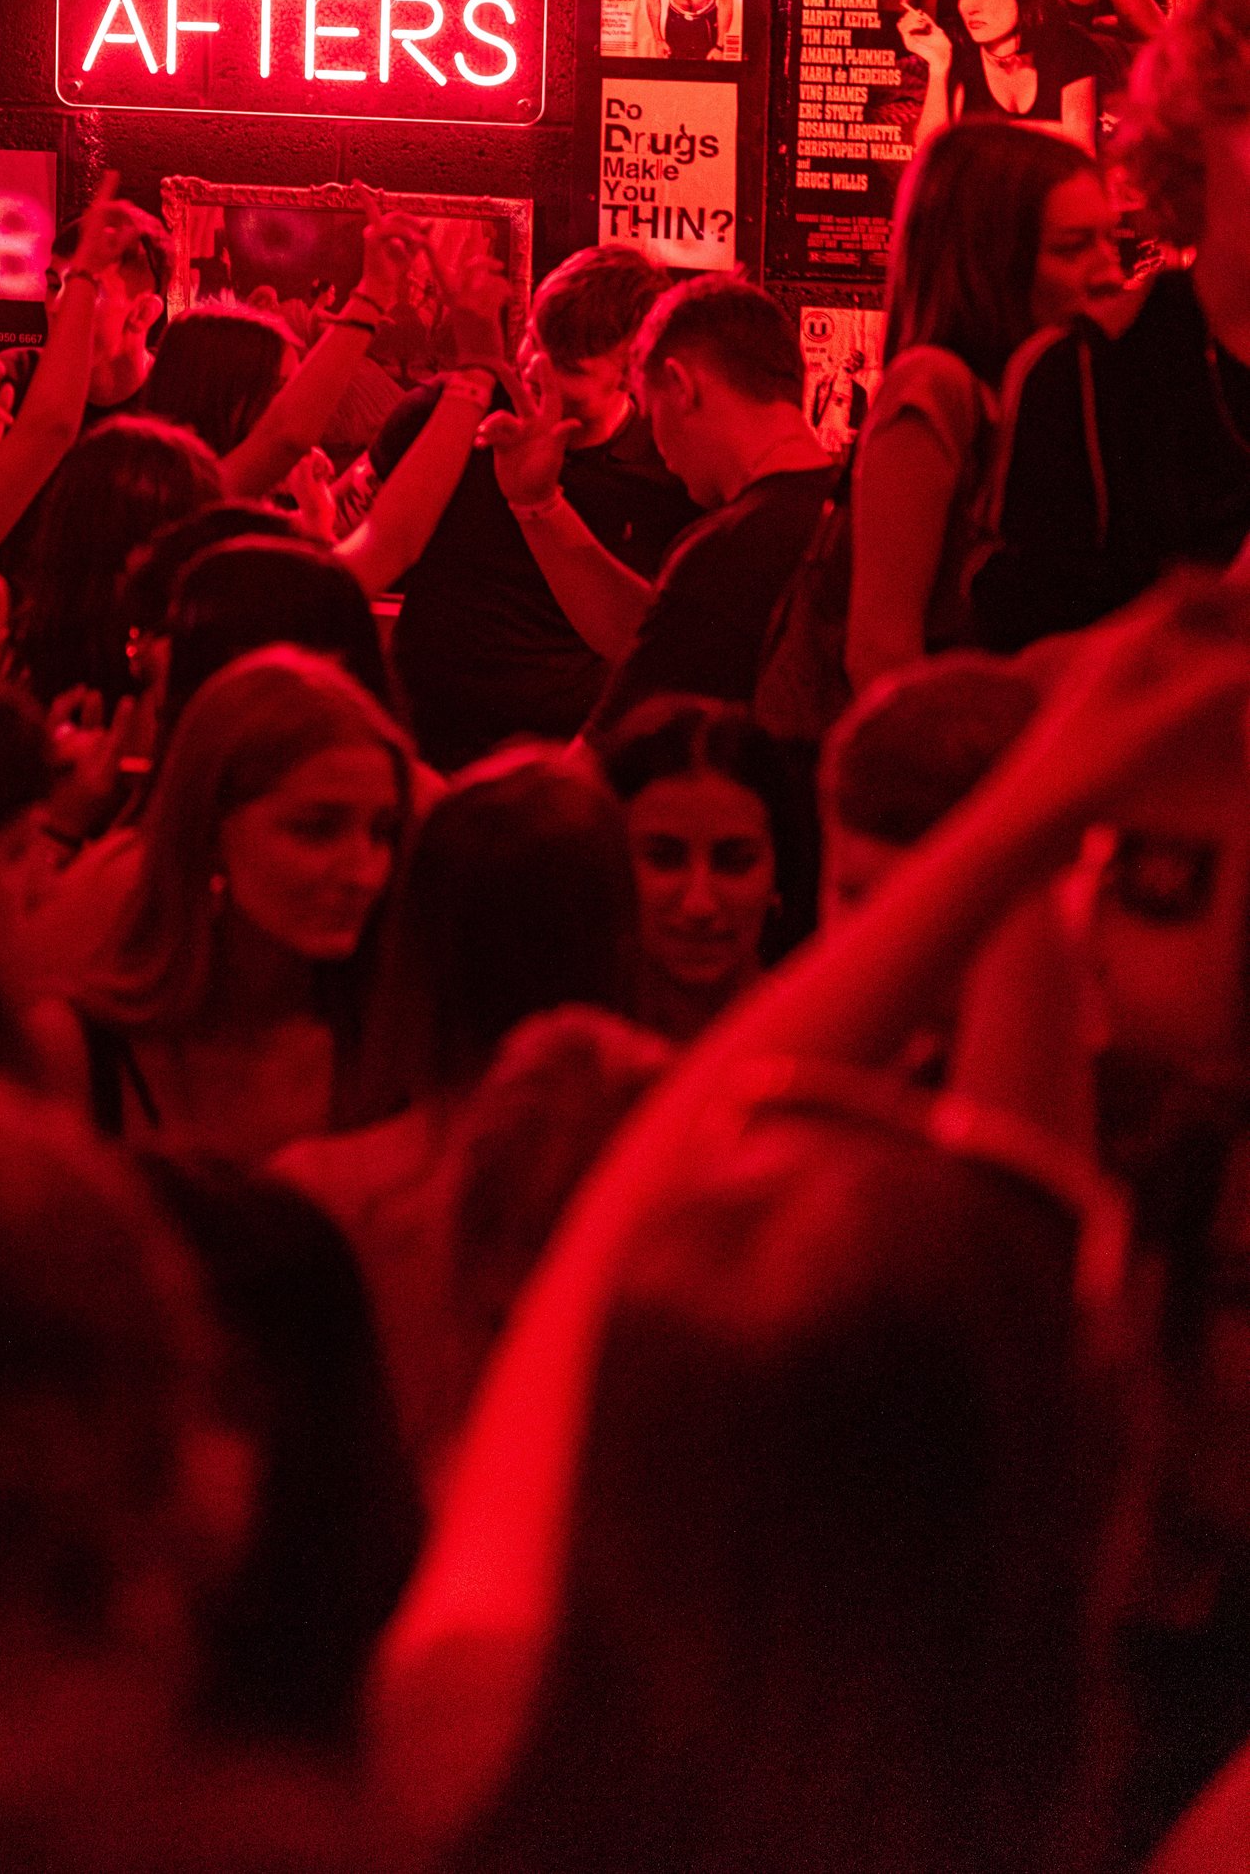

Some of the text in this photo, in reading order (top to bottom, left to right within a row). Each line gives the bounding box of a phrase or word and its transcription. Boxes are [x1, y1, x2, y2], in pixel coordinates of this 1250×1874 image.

[802, 9, 881, 28] HARVEY KEITEL
[801, 28, 852, 46] TIM ROTH
[800, 46, 896, 66] AMANDA PLUMMER
[800, 65, 902, 86] MARIA de MEDEIROS
[799, 83, 868, 103] VING RHAMES
[606, 98, 642, 120] Do
[798, 102, 864, 122] ERIC STOLTZ
[798, 121, 902, 142] ROSANNA ARQUETTE
[604, 123, 720, 165] Drugs
[797, 139, 913, 161] CHRISTOPHER WALKEN
[796, 158, 811, 170] and
[603, 179, 656, 202] You
[796, 171, 869, 192] BRUCE WILLIS
[602, 204, 734, 243] THIN?
[18, 333, 43, 344] 6667
